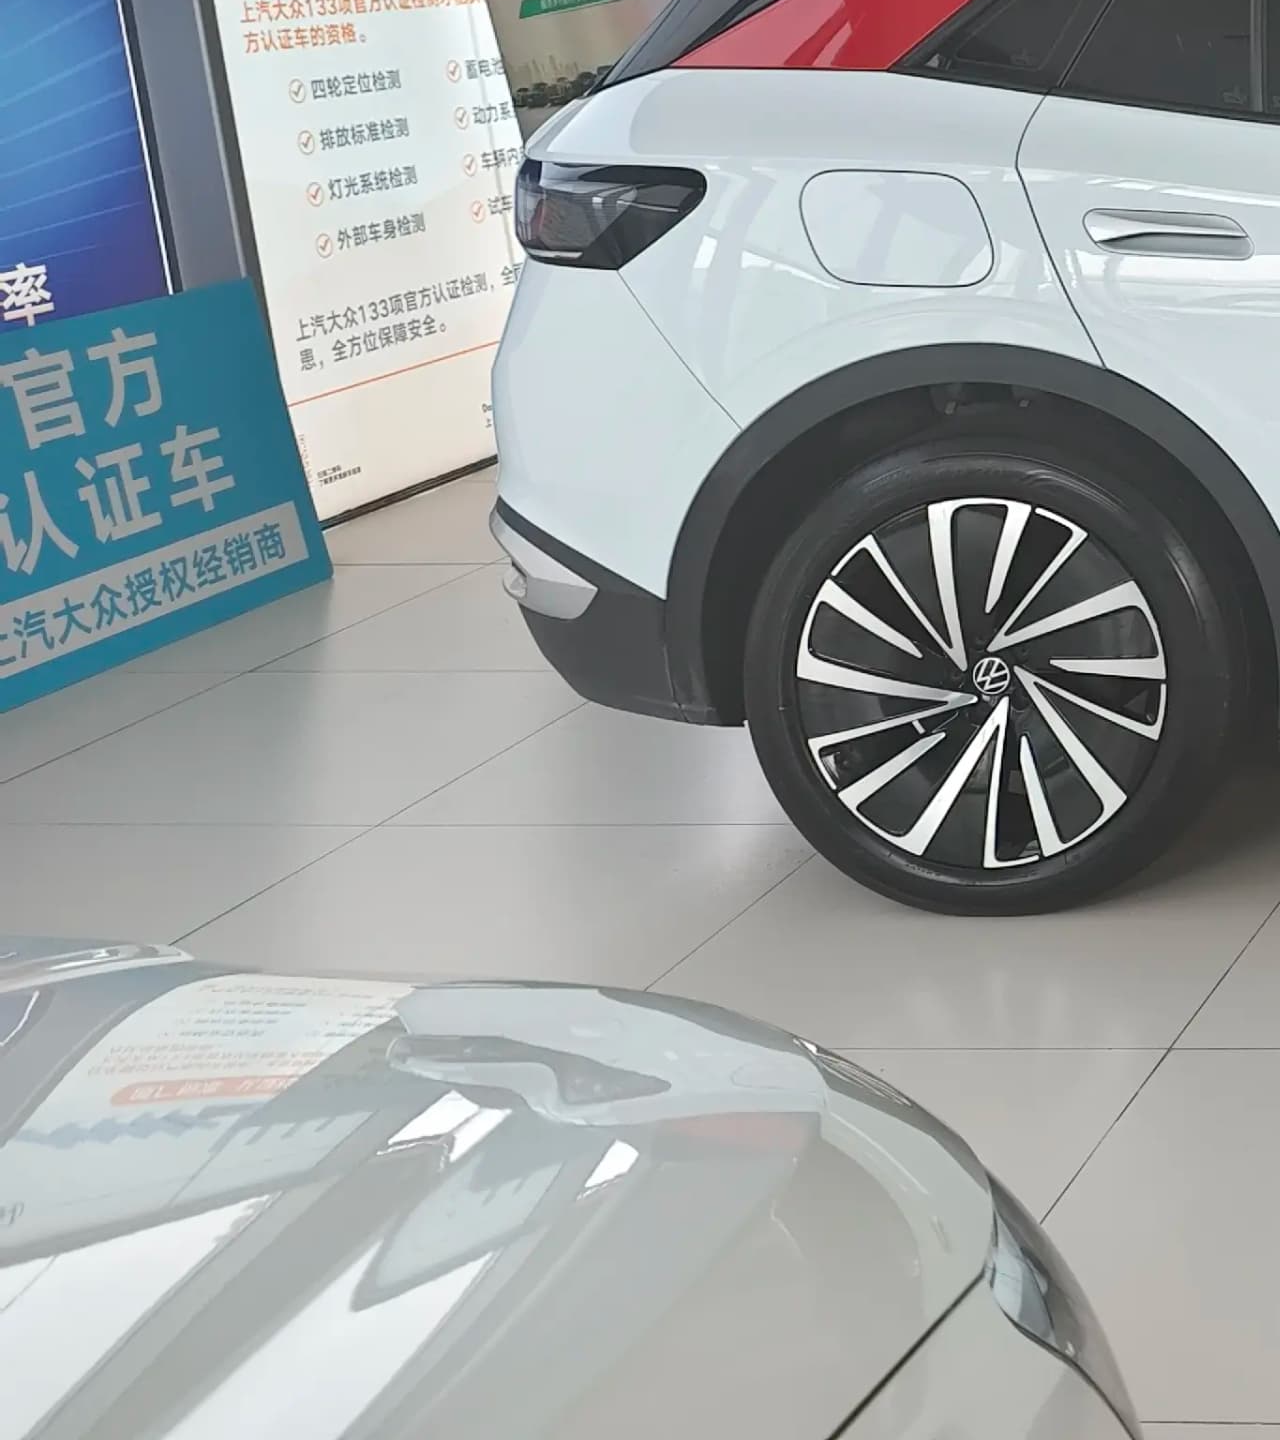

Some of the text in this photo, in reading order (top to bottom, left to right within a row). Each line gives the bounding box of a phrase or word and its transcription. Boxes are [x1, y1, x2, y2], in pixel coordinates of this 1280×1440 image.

[310, 69, 402, 100] 四轮定位检测
[319, 117, 410, 151] 排放标准检测
[328, 165, 418, 201] 灯光系统检测
[337, 212, 426, 250] 外部车身检测
[0, 326, 164, 451] 官方
[0, 424, 237, 576] 认证车
